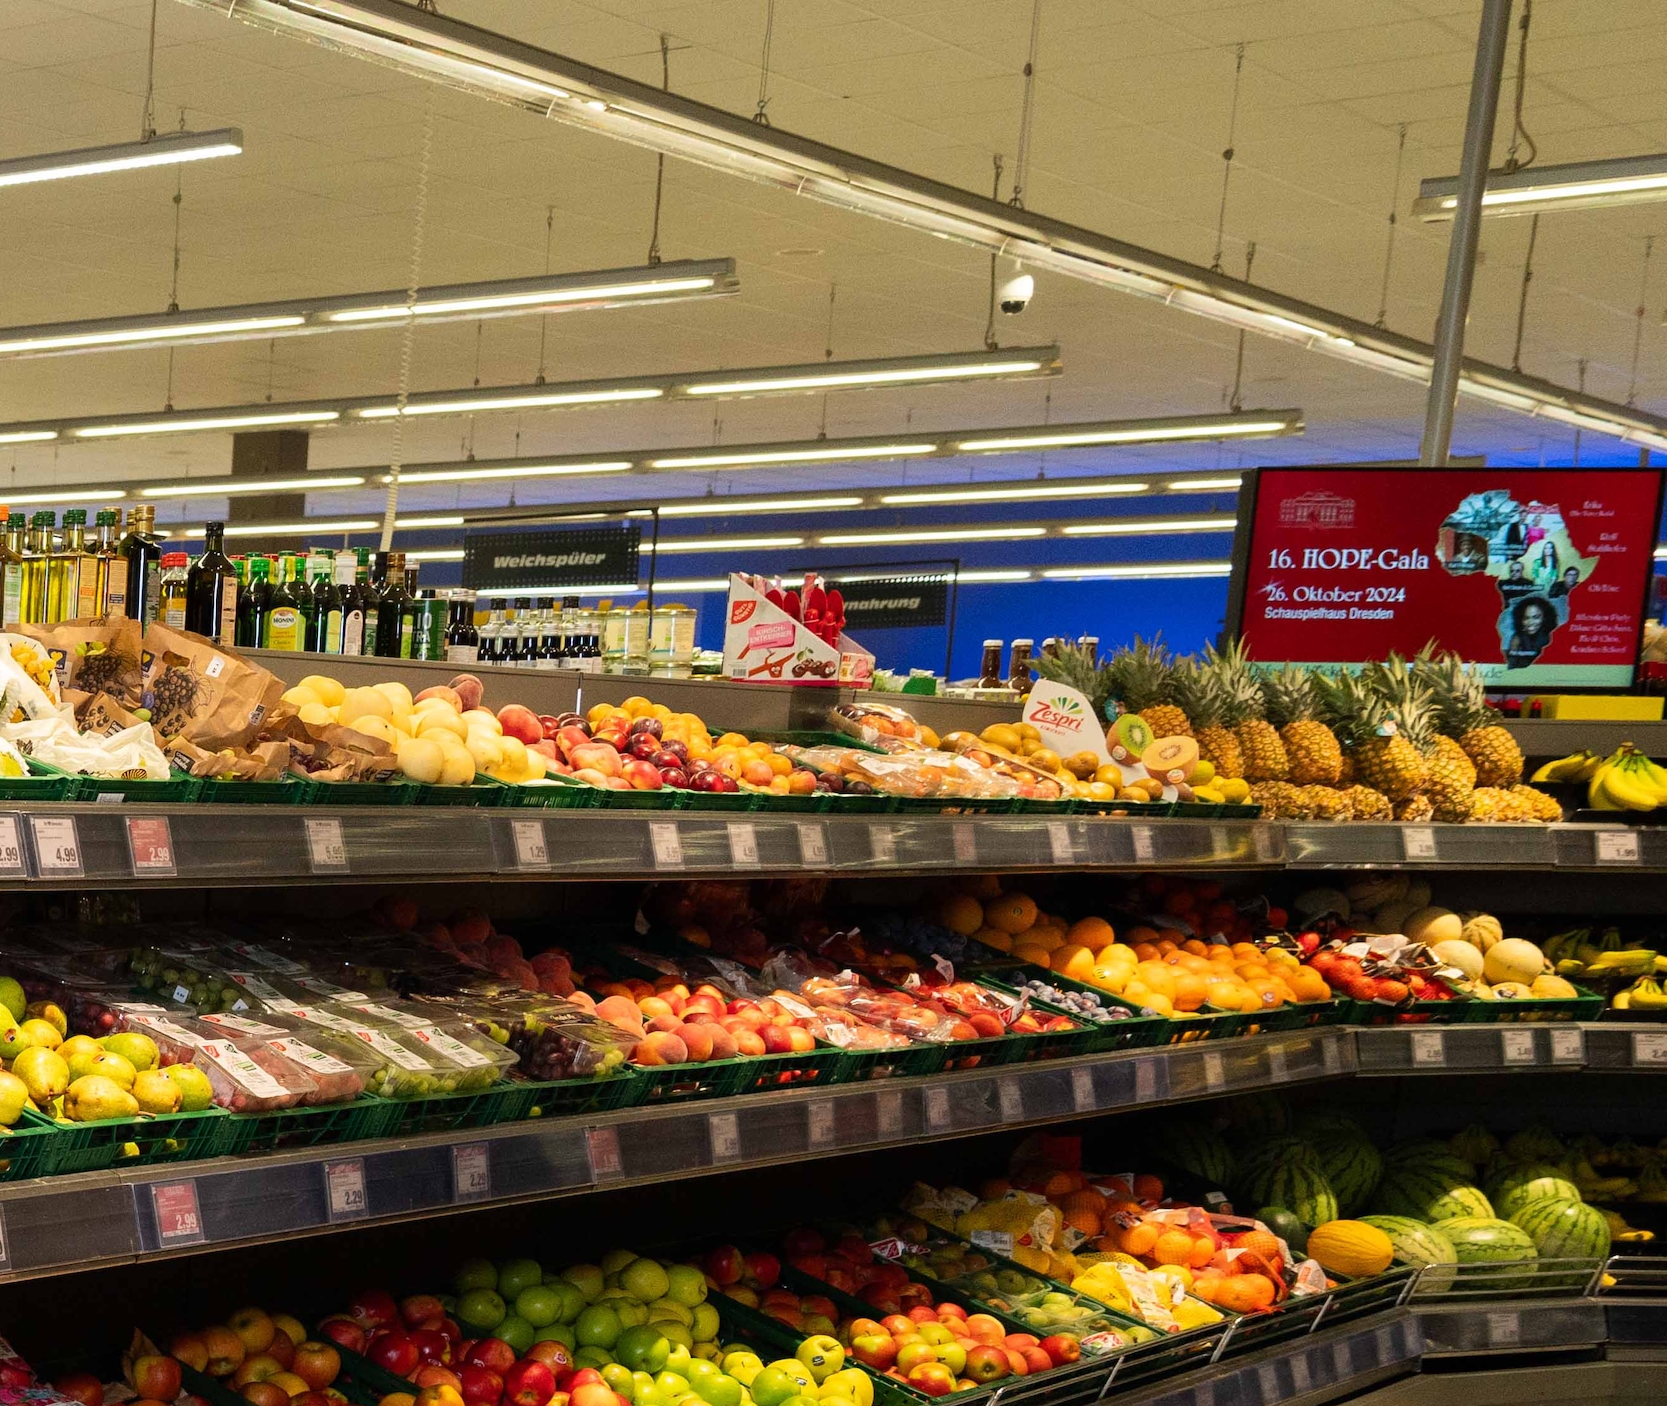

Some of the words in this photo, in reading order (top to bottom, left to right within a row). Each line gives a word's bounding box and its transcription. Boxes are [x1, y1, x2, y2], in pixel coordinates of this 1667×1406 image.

[493, 552, 606, 571] Weichspüler
[1268, 548, 1296, 570] 16.
[1302, 548, 1430, 571] HOPE-Gala
[1293, 586, 1364, 603] Oktober
[1365, 587, 1406, 603] 2024
[272, 615, 295, 625] MONINI
[1264, 606, 1348, 621] Schauspielhaus
[1349, 607, 1395, 620] Dresden
[1029, 701, 1084, 734] Zespri
[55, 848, 77, 862] 4.99
[148, 847, 170, 861] 2.99
[175, 1212, 197, 1228] 2.99
